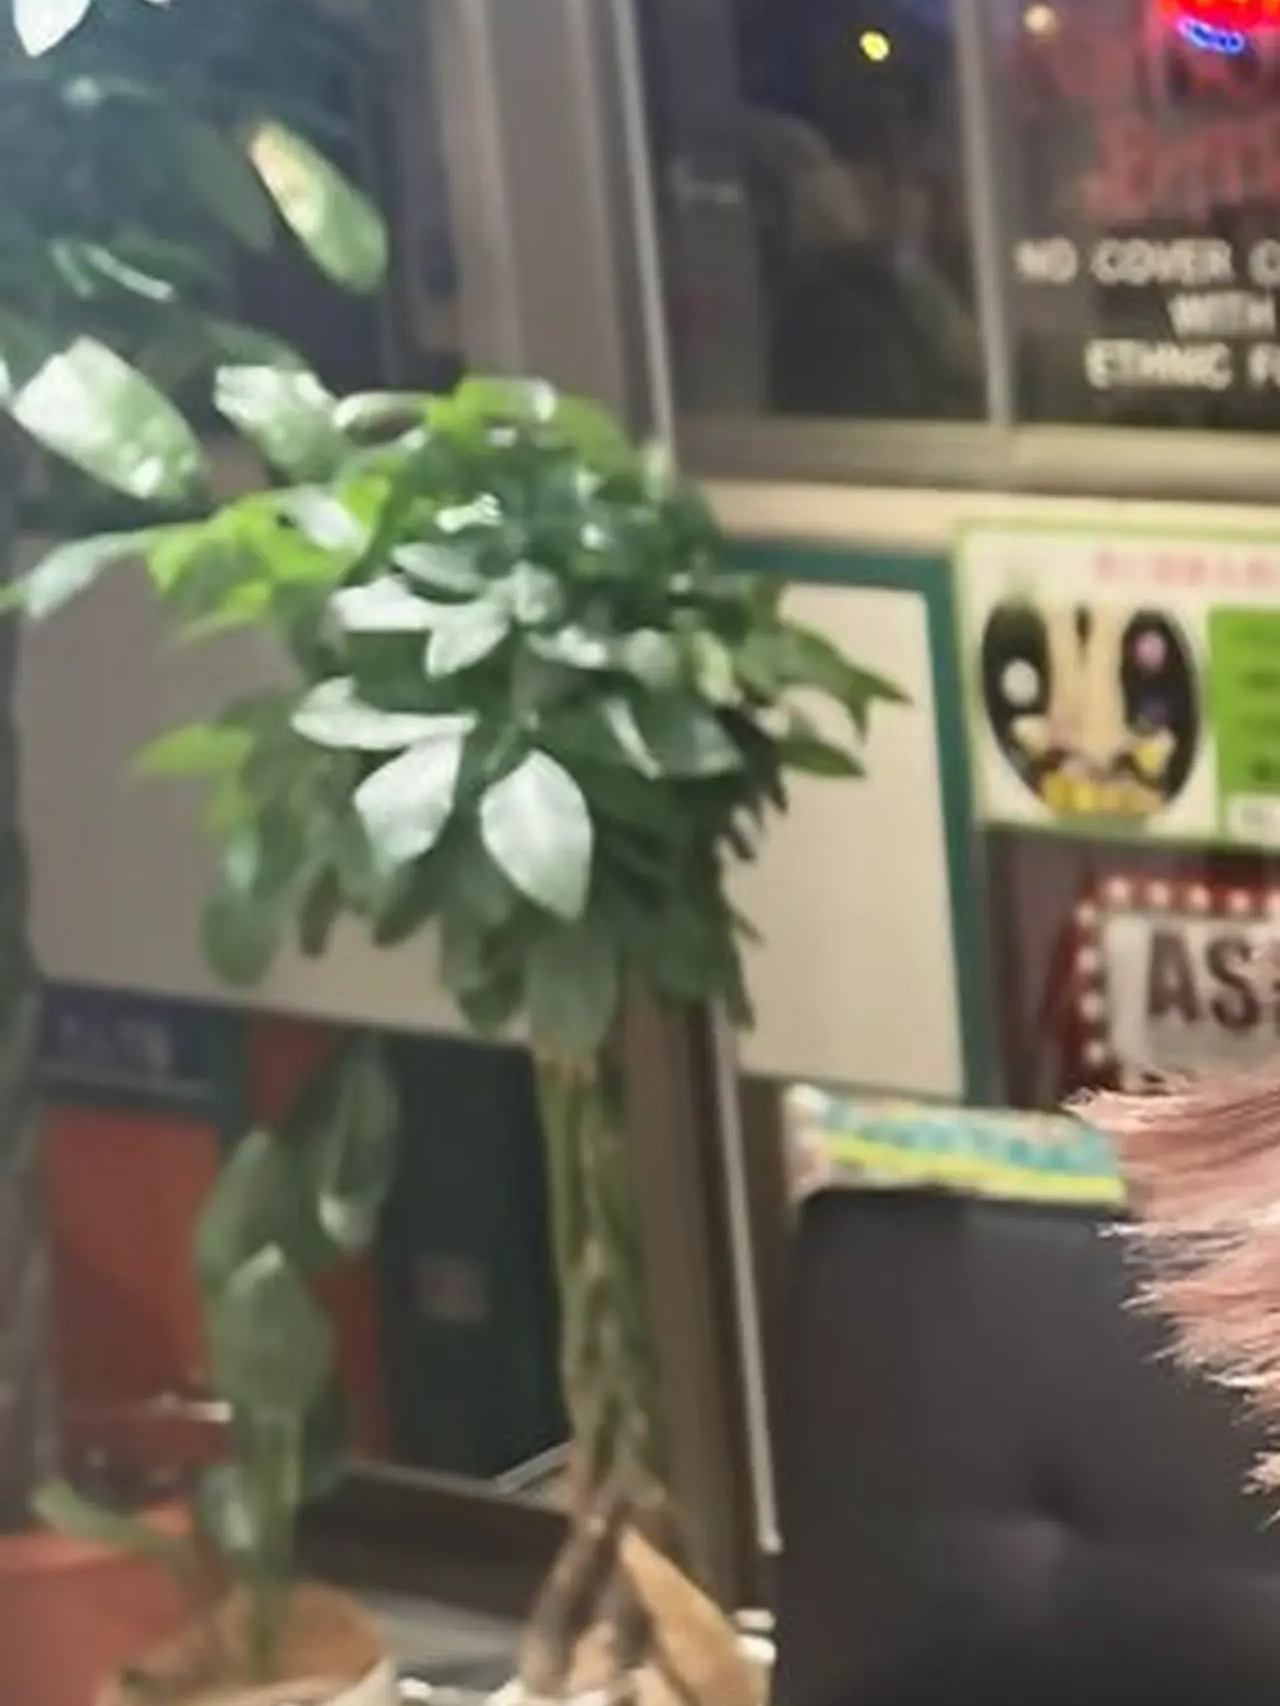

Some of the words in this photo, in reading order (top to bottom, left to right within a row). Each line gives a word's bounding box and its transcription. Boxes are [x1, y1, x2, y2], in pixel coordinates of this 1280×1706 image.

[1091, 238, 1234, 285] COVER
[1168, 293, 1275, 336] WITH
[1086, 340, 1232, 389] ETHNIC
